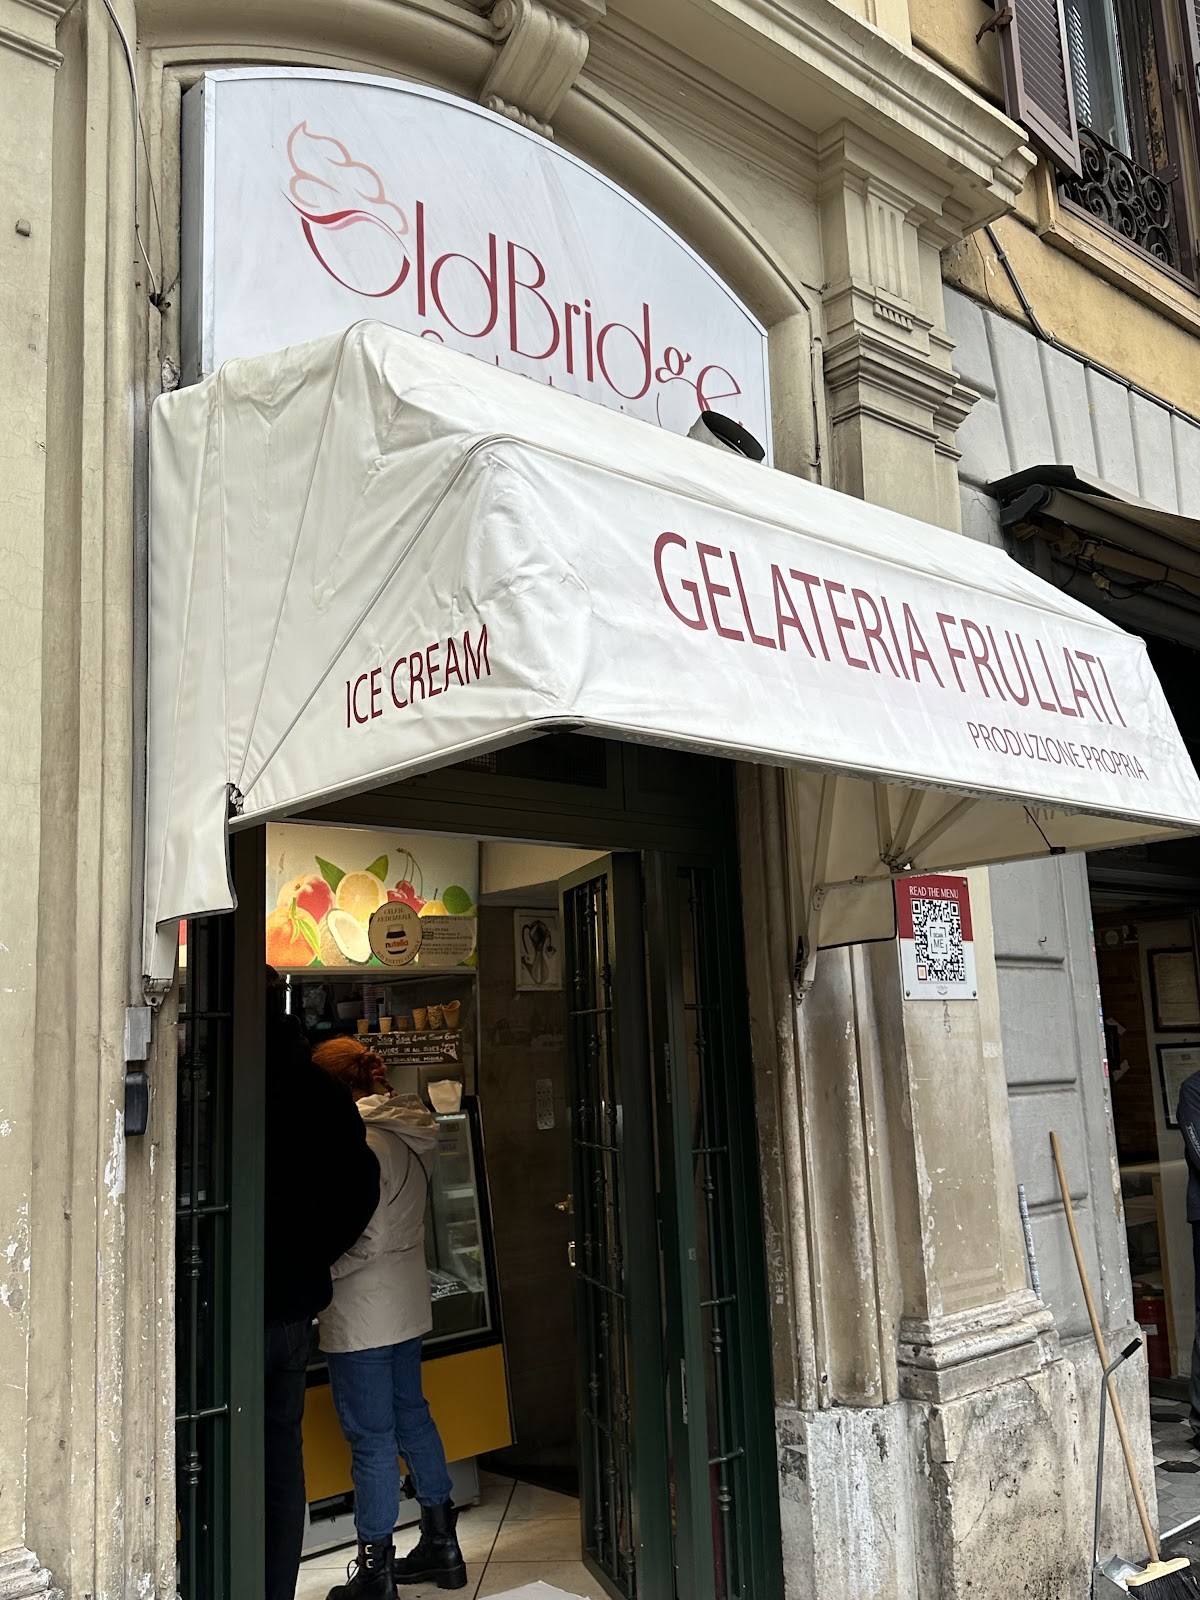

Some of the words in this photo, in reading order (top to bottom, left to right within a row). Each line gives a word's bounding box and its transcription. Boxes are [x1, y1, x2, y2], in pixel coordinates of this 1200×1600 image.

[653, 531, 945, 688] GELATERIA
[936, 611, 1127, 728] FRULLATI
[346, 667, 382, 728] ICE
[391, 624, 491, 709] CREAM
[967, 721, 1084, 768] PRODUZIONE
[1081, 744, 1149, 781] PROPRIA
[909, 886, 927, 897] READ
[927, 887, 940, 897] THE
[941, 889, 959, 899] MENU
[385, 939, 409, 948] nutella
[934, 939, 944, 948] ME
